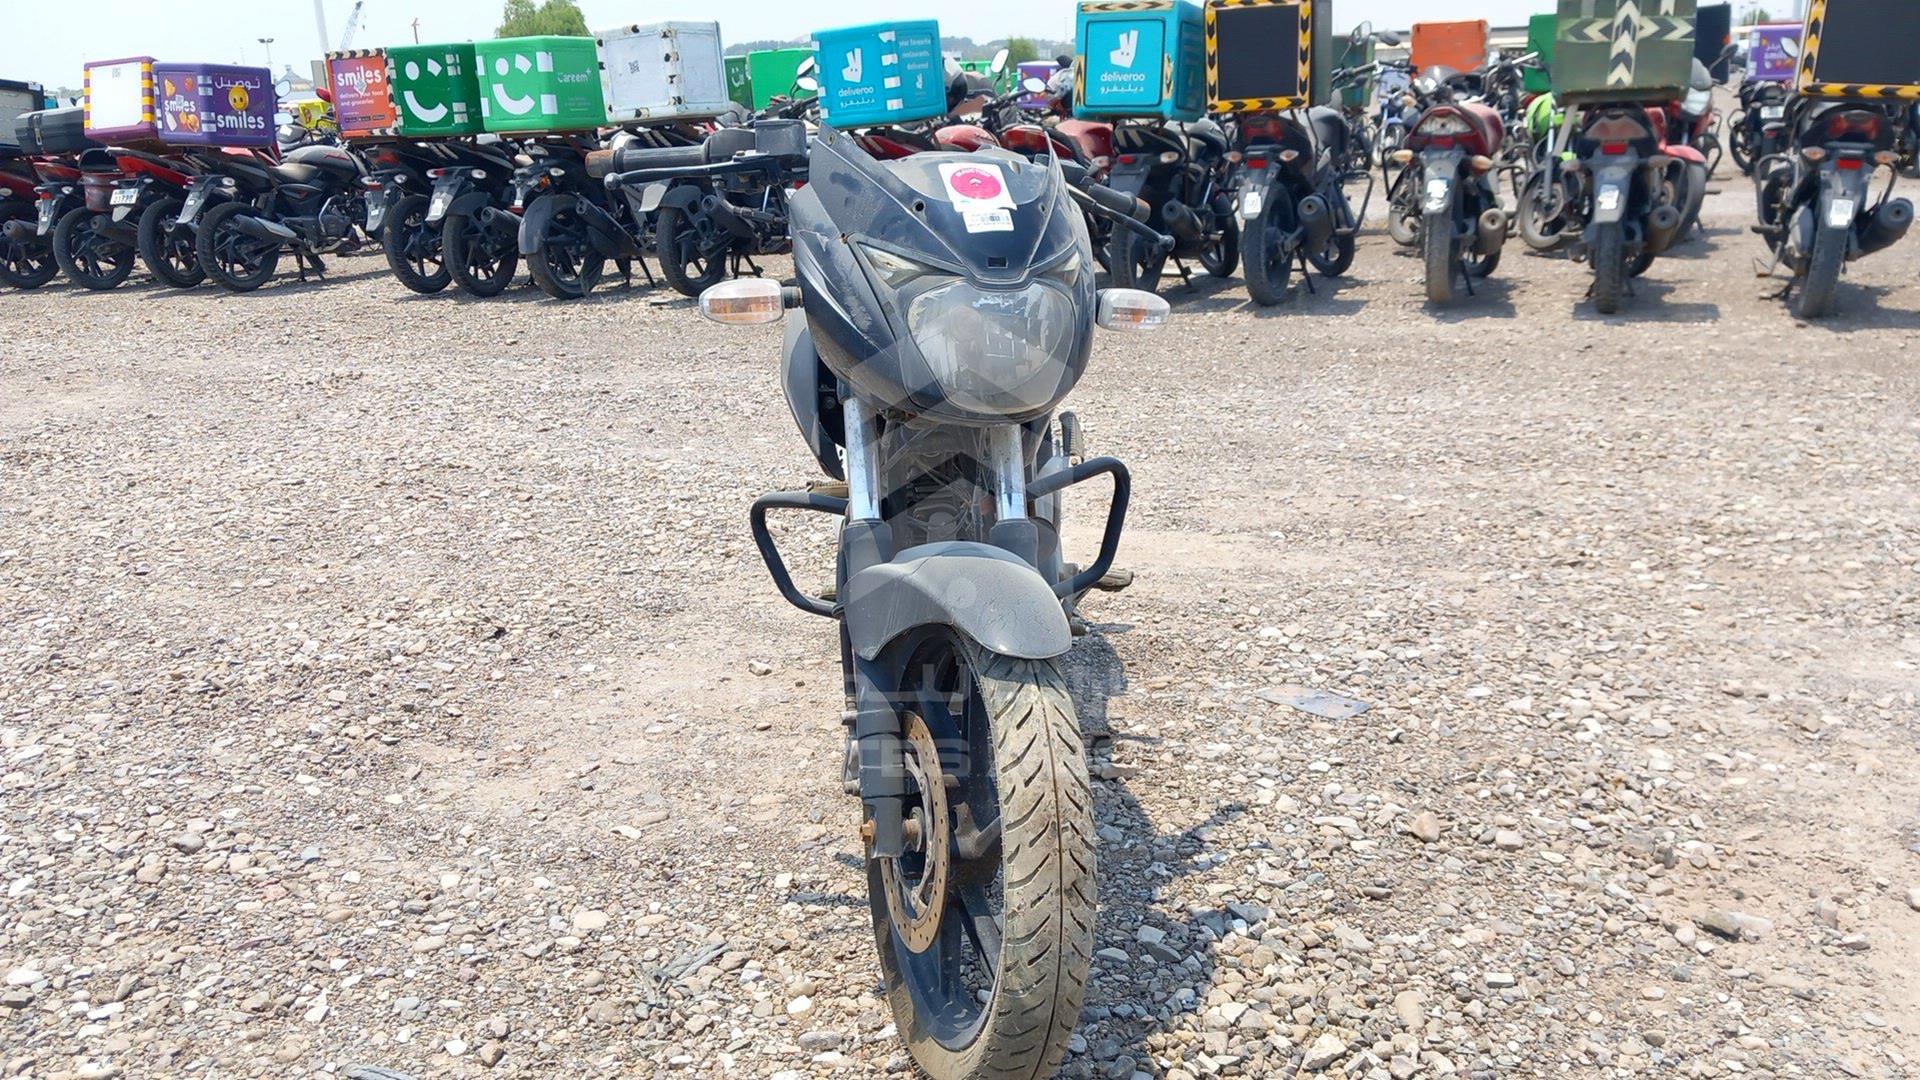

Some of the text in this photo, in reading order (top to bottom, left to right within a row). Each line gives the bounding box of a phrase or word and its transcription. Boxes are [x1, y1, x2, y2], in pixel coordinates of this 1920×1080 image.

[337, 65, 382, 87] smiles
[1100, 71, 1146, 82] deliveroo
[838, 86, 874, 97] deliveroo
[217, 110, 265, 129] smiles
